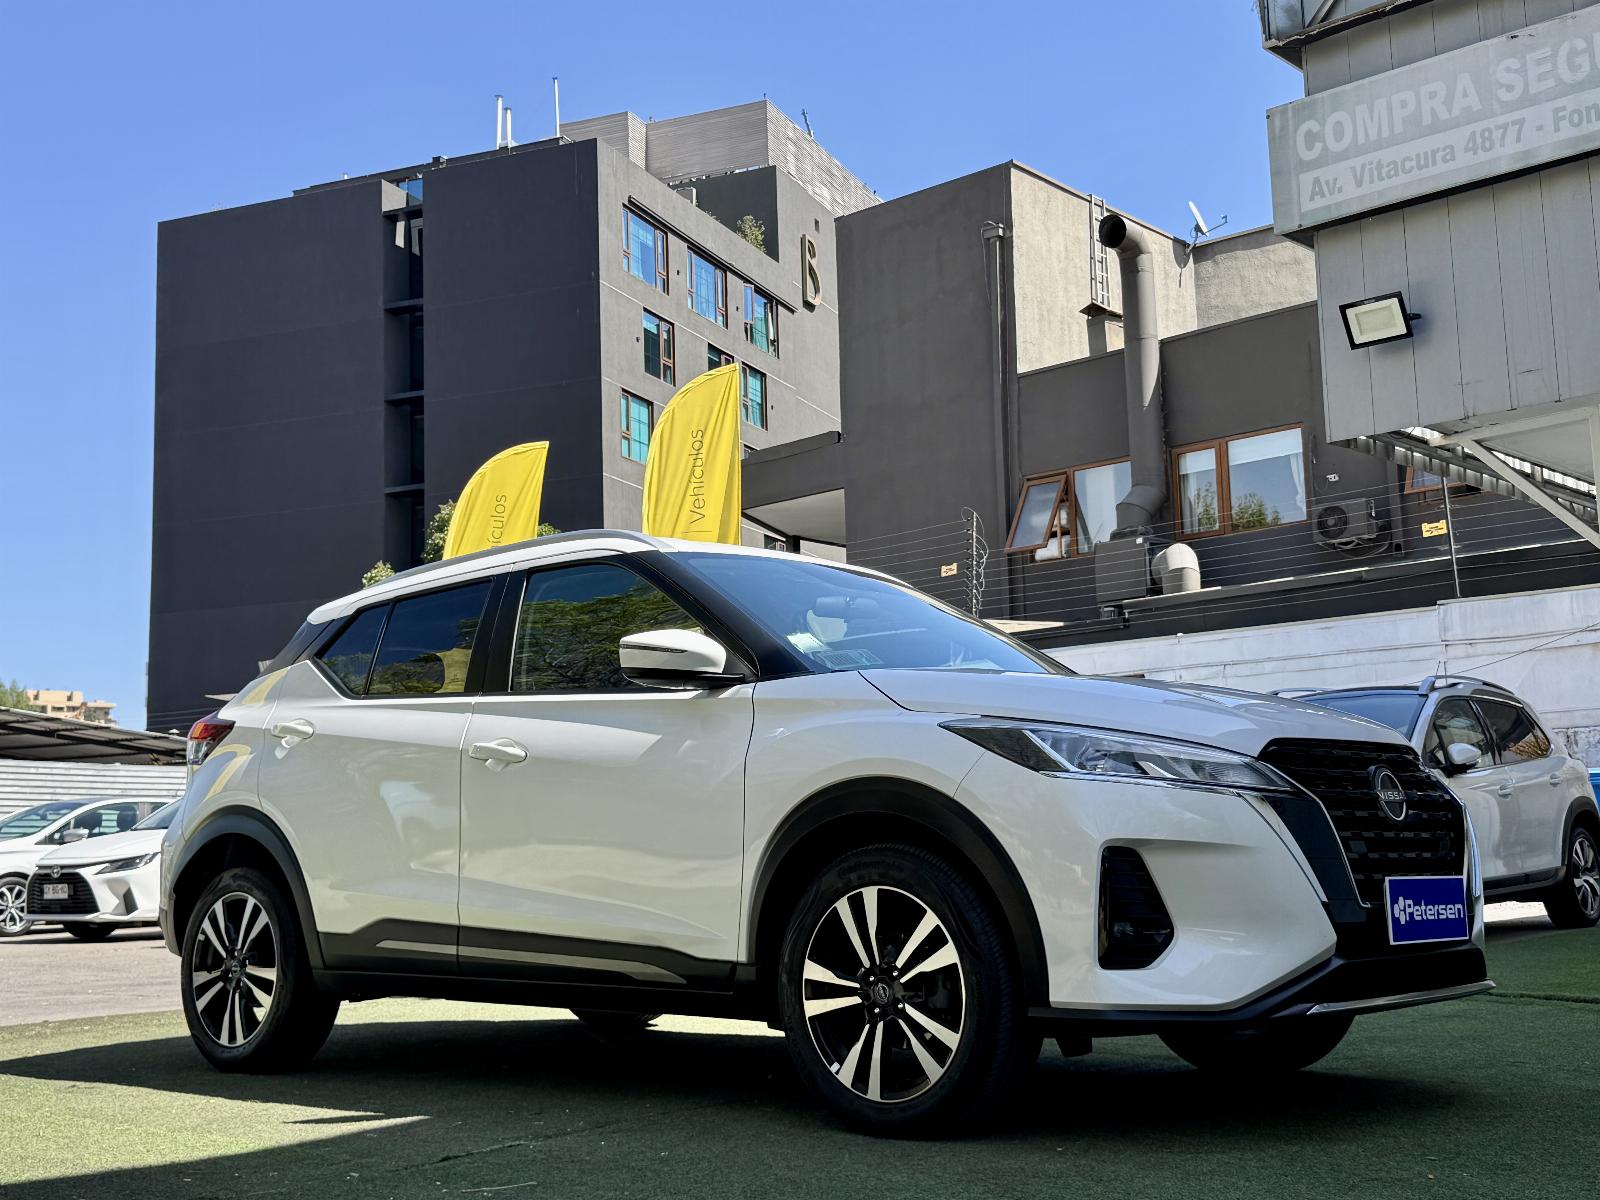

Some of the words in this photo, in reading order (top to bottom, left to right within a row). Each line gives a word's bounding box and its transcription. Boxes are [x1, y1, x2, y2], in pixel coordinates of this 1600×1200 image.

[1296, 72, 1482, 161] COMPRA
[1496, 32, 1600, 102] SEG
[1309, 175, 1343, 202] Av.
[1350, 143, 1456, 188] Vitacura
[1464, 117, 1526, 157] 4877
[688, 429, 706, 525] Vehículos
[1405, 899, 1464, 921] Petersen
